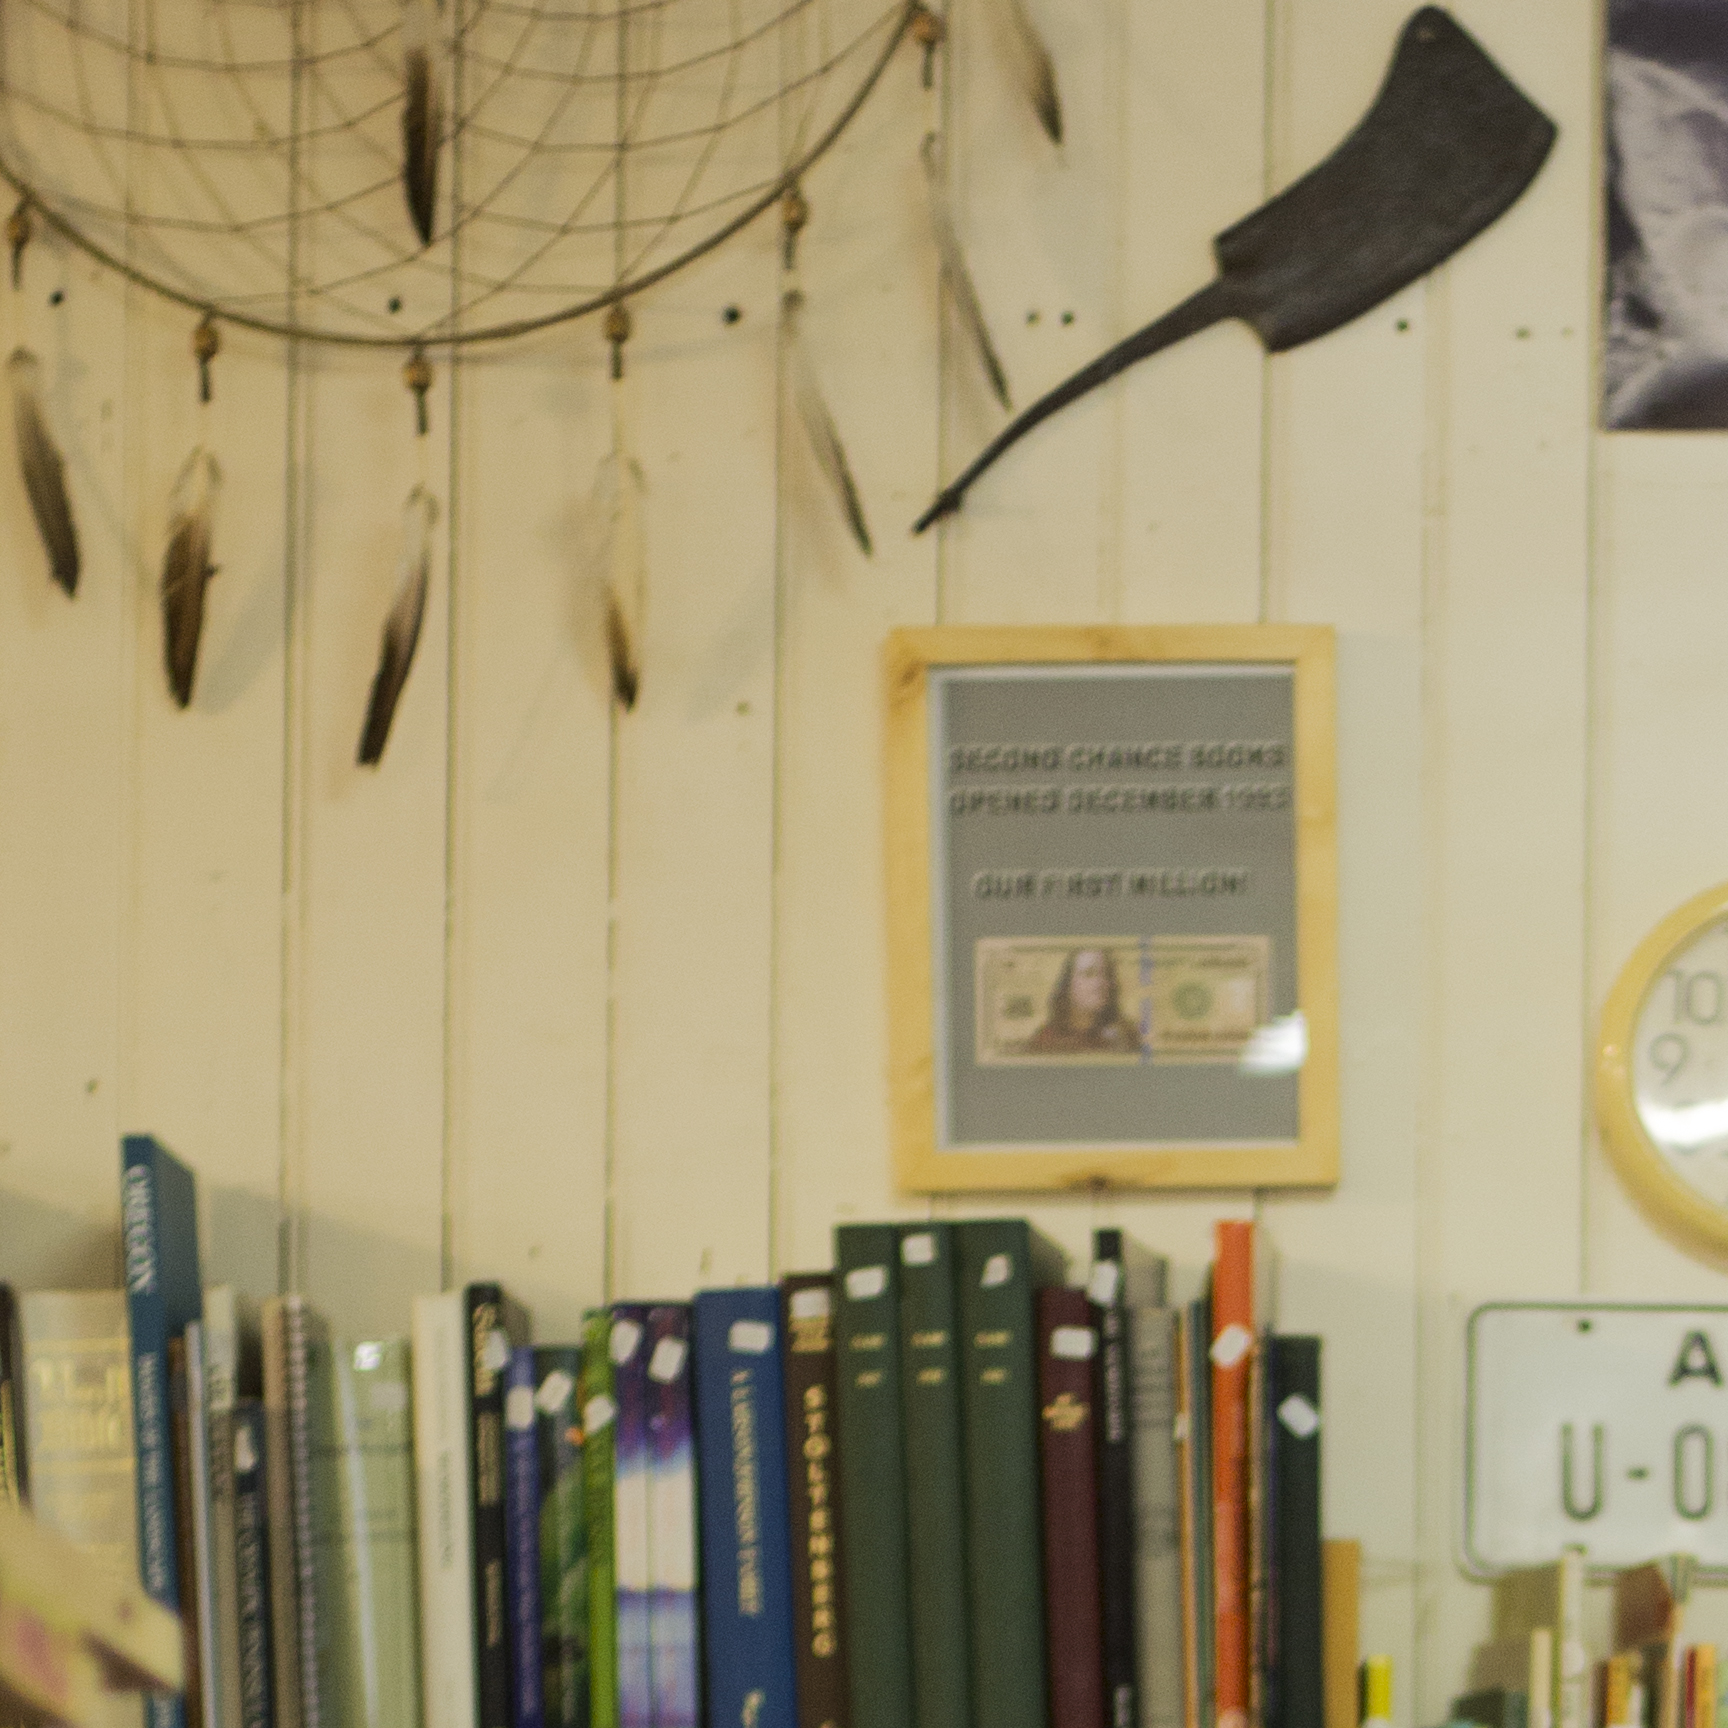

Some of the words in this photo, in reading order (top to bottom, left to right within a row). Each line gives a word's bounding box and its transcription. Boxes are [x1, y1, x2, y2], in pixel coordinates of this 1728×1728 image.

[951, 744, 1058, 772] SECOND
[1066, 742, 1183, 771] CHANCE
[1193, 741, 1286, 770] BOOKS
[951, 785, 1058, 814] OPENED
[1066, 784, 1217, 813] DECEMBER
[972, 871, 1034, 898] OUR
[1041, 871, 1123, 898] FIRST
[1667, 967, 1727, 1027] 10
[1649, 1032, 1690, 1088] 9
[802, 1384, 834, 1660] STOLTENBERG
